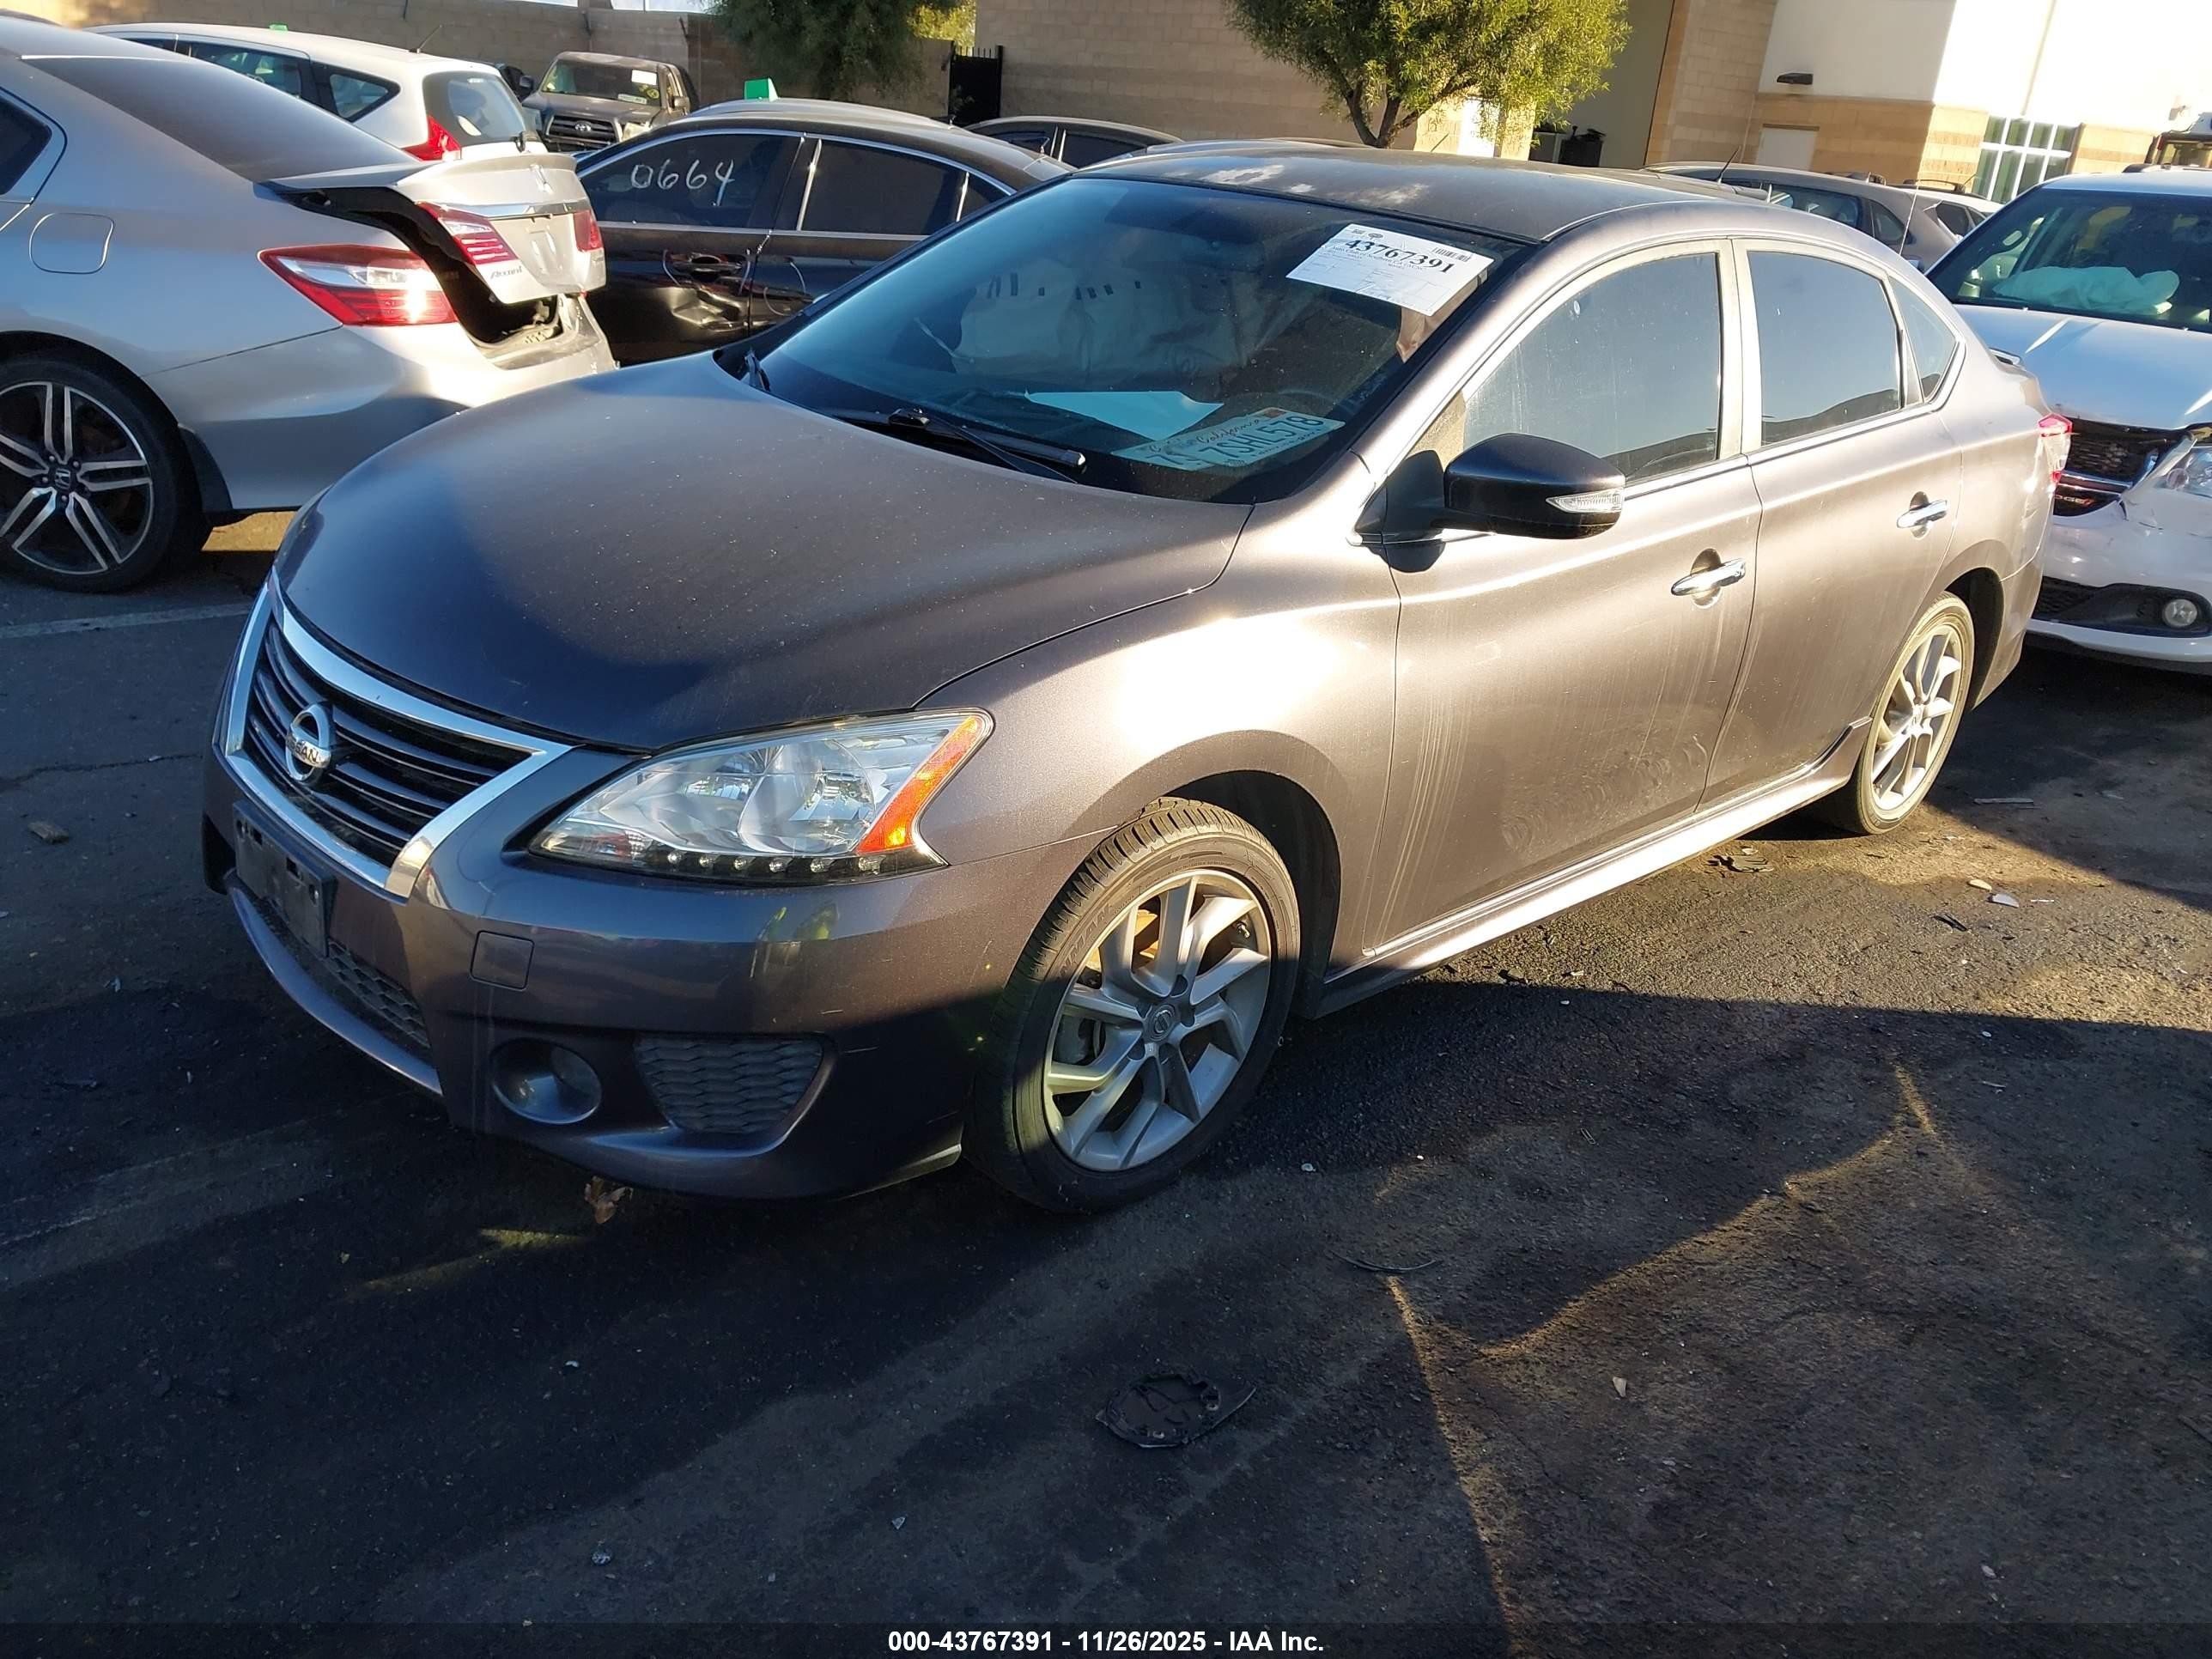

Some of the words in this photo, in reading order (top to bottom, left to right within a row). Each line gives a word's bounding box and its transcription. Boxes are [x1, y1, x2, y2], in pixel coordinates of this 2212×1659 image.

[630, 158, 735, 207] 0664
[1345, 239, 1455, 274] 43767391
[1197, 418, 1261, 444] California
[1199, 416, 1325, 459] 7SHL578
[2055, 495, 2082, 505] DGE
